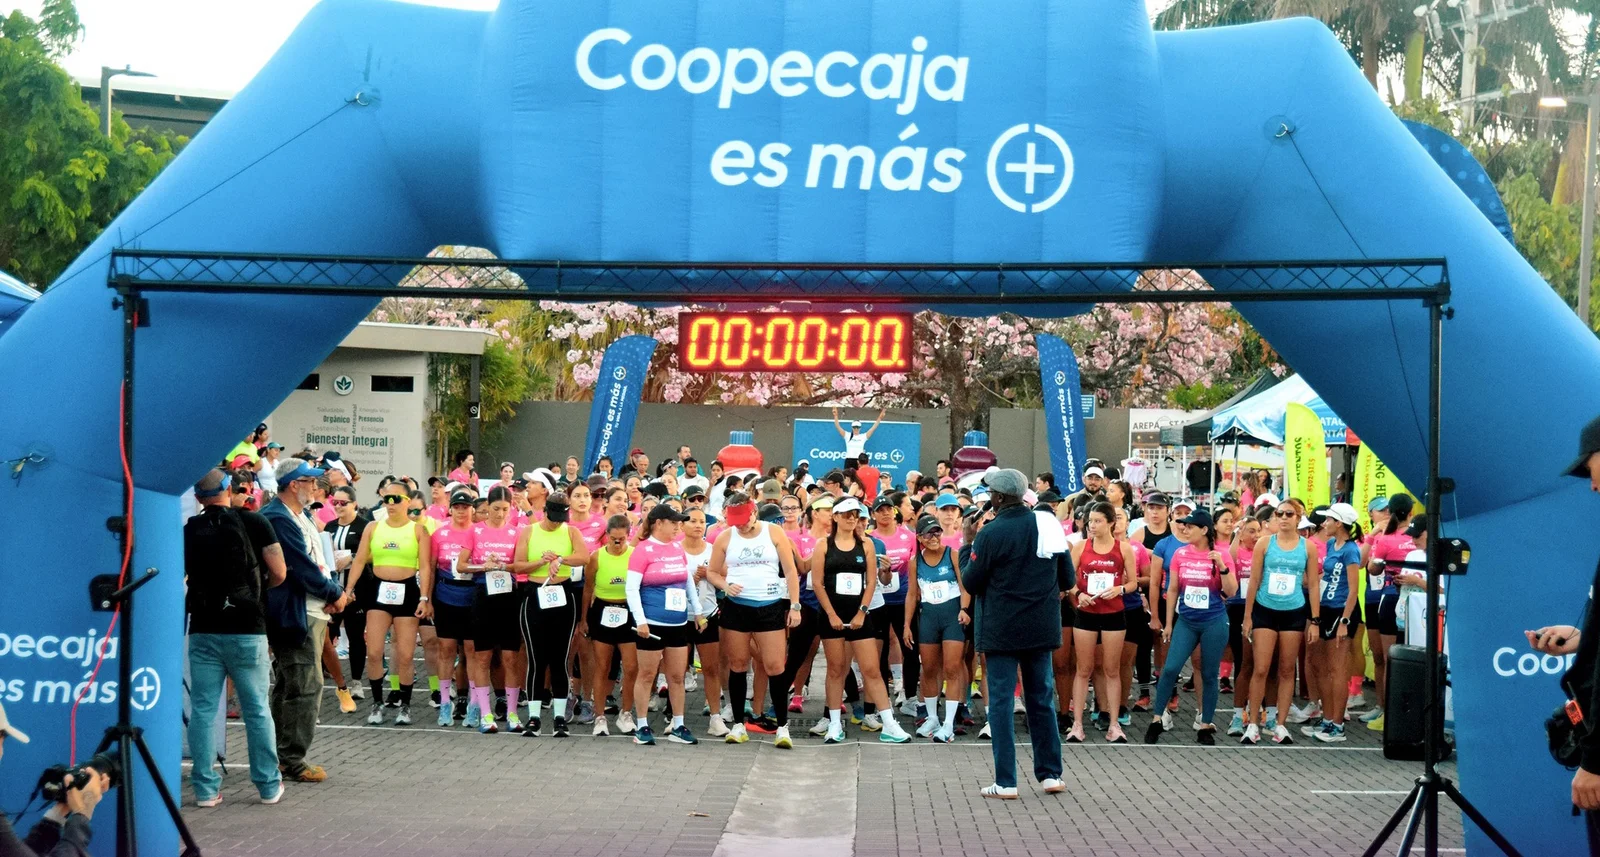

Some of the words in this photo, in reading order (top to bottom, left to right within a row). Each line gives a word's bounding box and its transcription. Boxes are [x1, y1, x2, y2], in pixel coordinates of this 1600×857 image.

[575, 28, 969, 115] Coopecaja
[710, 140, 792, 188] es
[805, 122, 967, 193] más
[610, 382, 621, 408] más
[323, 415, 350, 424] Orgánico
[358, 415, 384, 423] Presencia
[1132, 422, 1160, 430] AREPA
[306, 433, 350, 445] Bienestar
[352, 435, 388, 447] integral
[874, 451, 888, 460] es
[1063, 430, 1077, 492] Coopecaja
[494, 579, 505, 588] 62
[847, 581, 852, 589] 9
[1095, 581, 1106, 589] 74
[1276, 581, 1287, 590] 75
[1327, 562, 1344, 600] adidas
[385, 590, 397, 600] 35
[546, 592, 558, 602] 38
[932, 590, 942, 599] 10
[609, 614, 620, 623] 36
[0, 679, 26, 702] s
[33, 670, 118, 704] más
